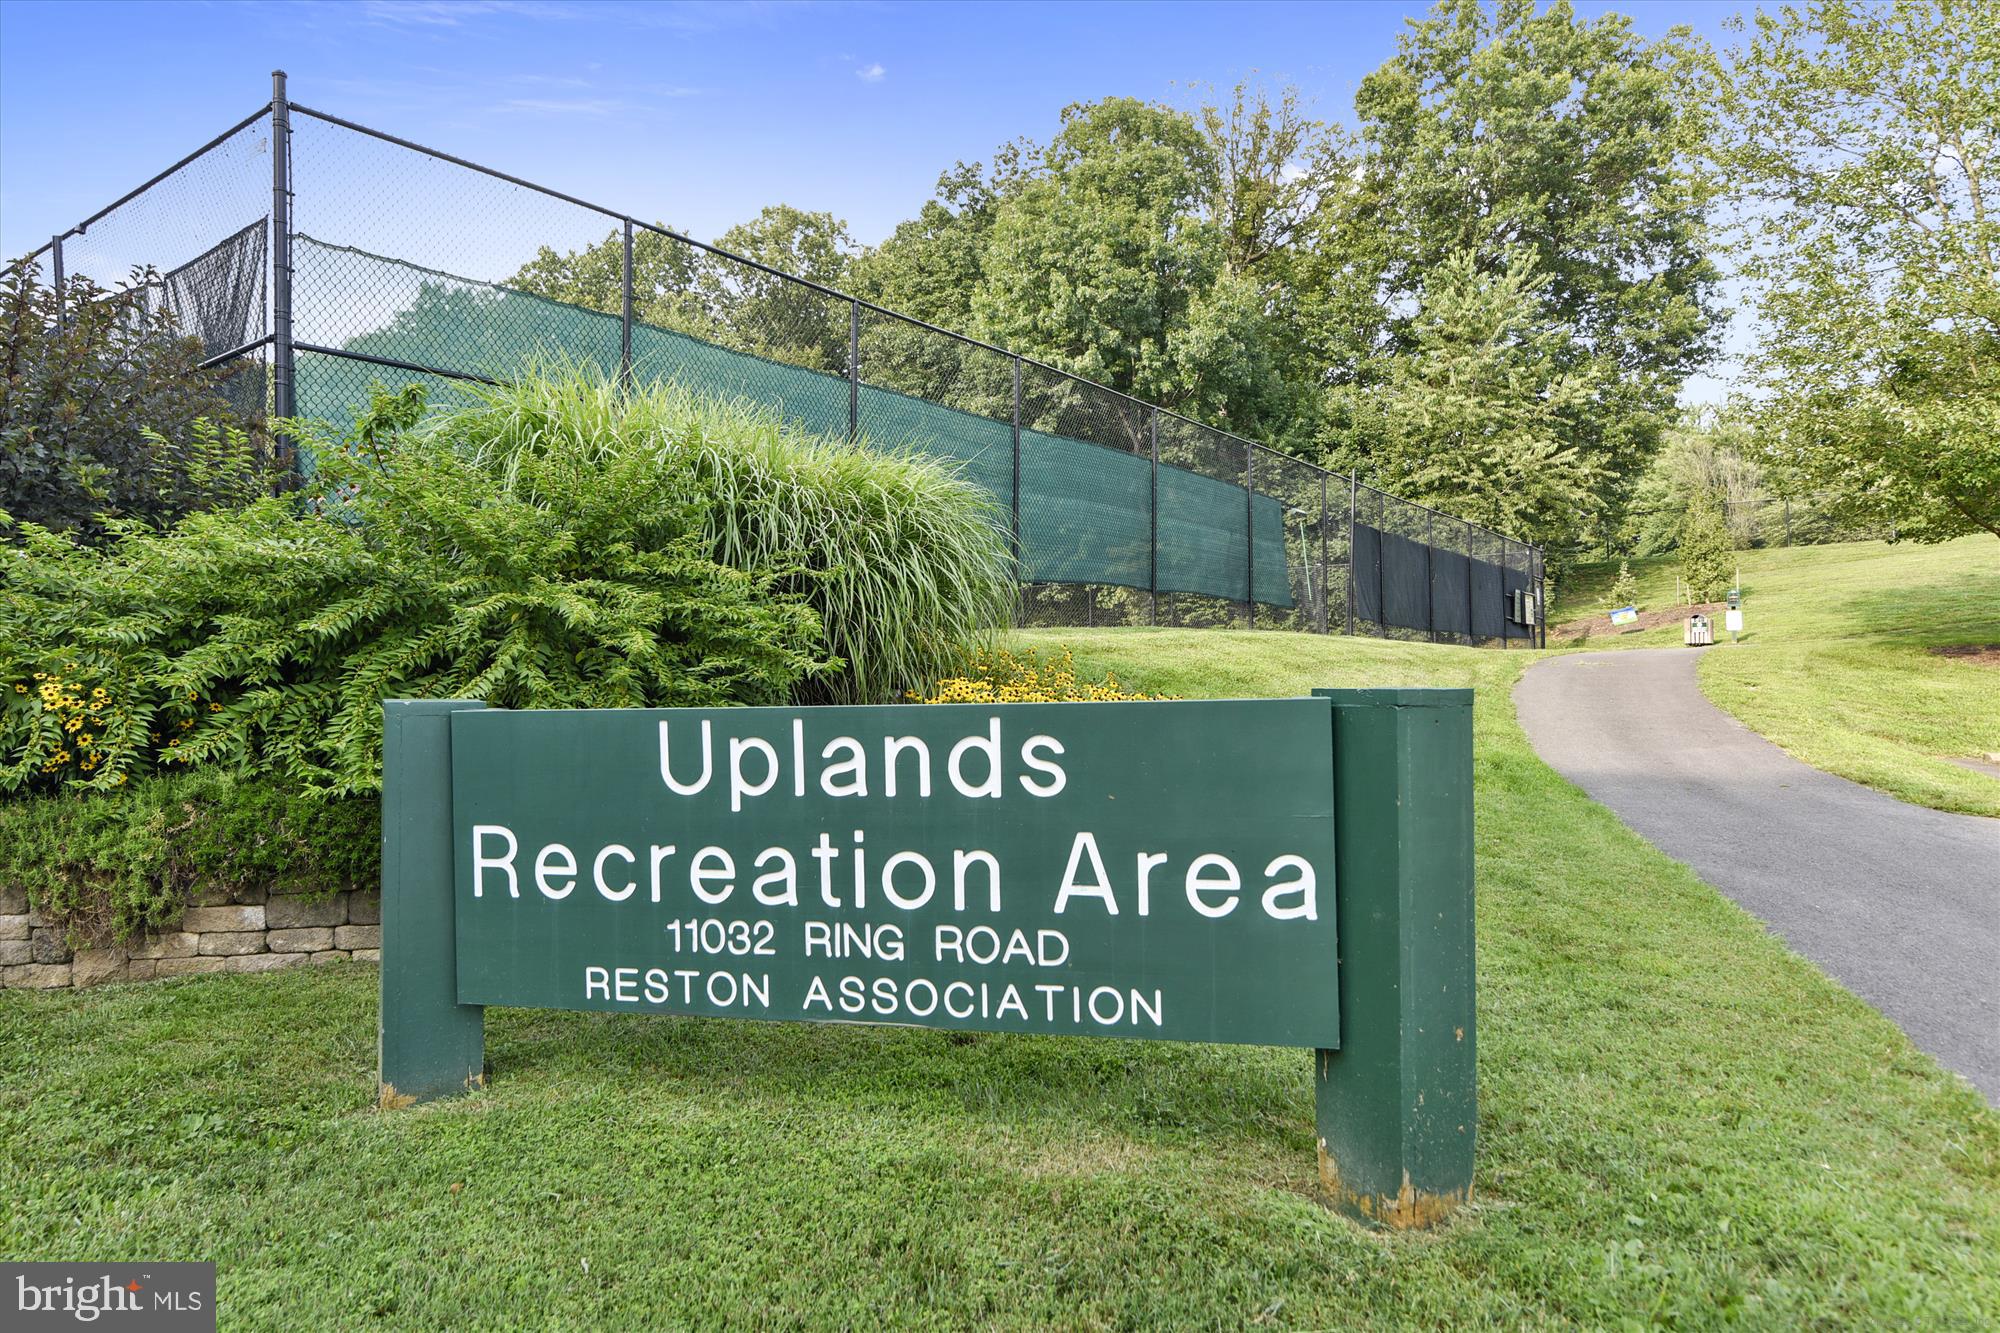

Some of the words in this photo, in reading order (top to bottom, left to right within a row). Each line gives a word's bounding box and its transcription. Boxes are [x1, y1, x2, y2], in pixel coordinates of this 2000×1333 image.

[658, 716, 1067, 813] Uplands
[472, 824, 1001, 913] Recreation
[1053, 831, 1318, 921] Area
[666, 918, 776, 956] 11032
[804, 921, 905, 961] RING
[935, 924, 1070, 967] ROAD
[585, 966, 770, 1008] RESTON
[802, 975, 1163, 1026] ASSOCIATION
